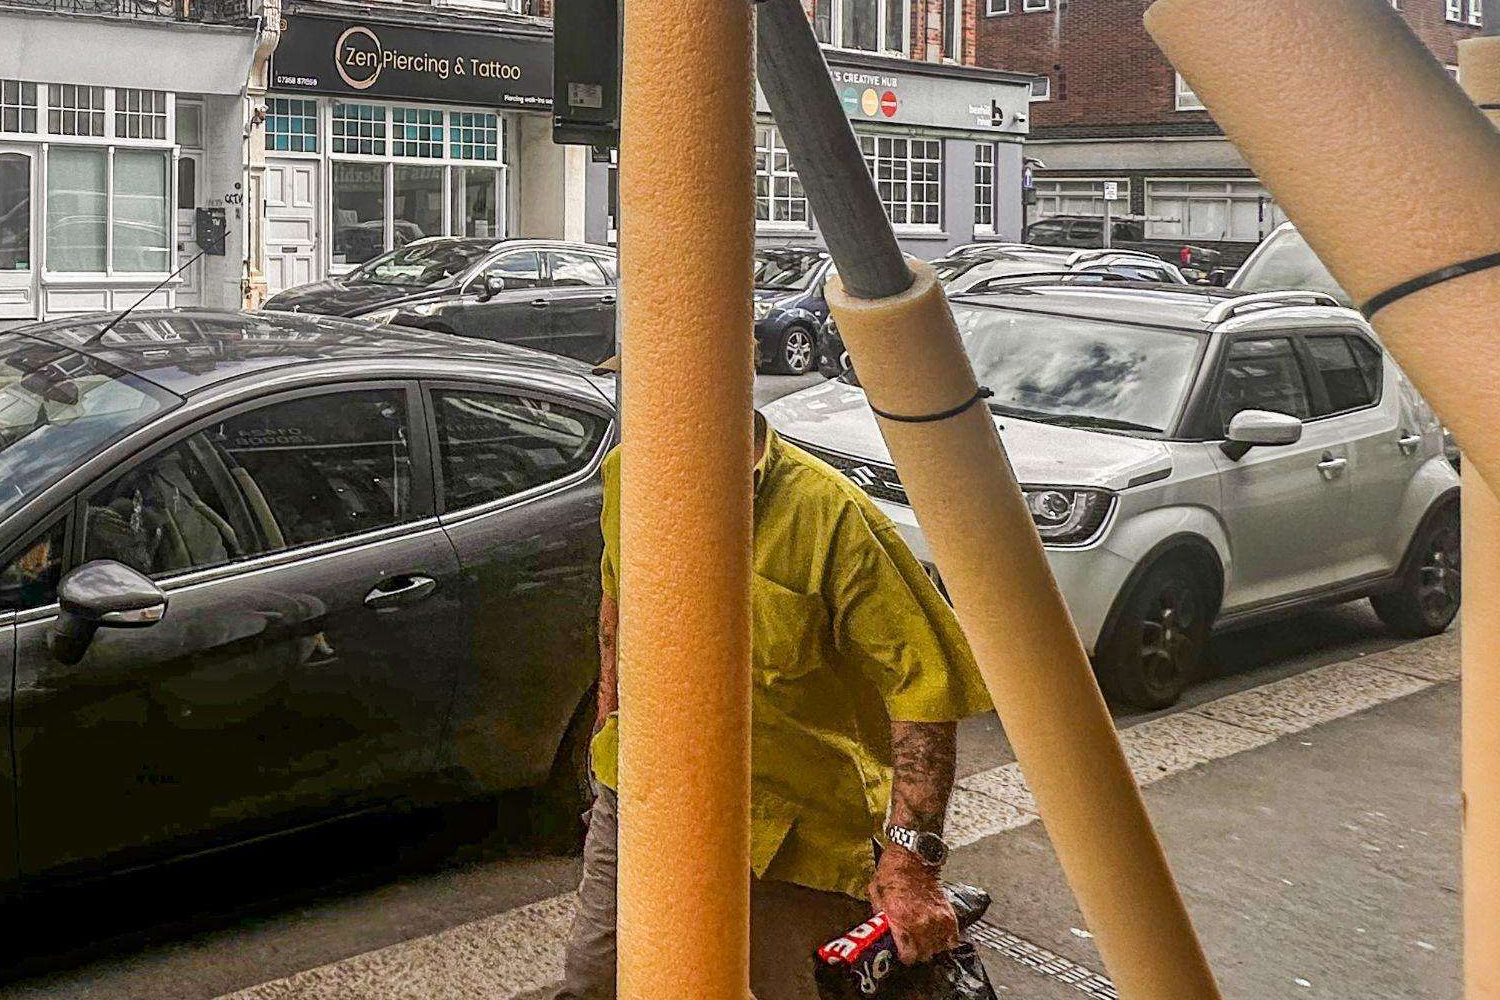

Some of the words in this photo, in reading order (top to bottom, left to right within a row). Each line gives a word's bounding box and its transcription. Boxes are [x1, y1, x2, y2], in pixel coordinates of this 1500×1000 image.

[345, 46, 378, 67] Zen
[382, 50, 450, 79] Piercing
[453, 56, 466, 75] &
[470, 59, 521, 80] Tattoo
[843, 72, 880, 86] CREATIVE
[881, 77, 898, 88] HUB
[504, 94, 524, 104] Piercing
